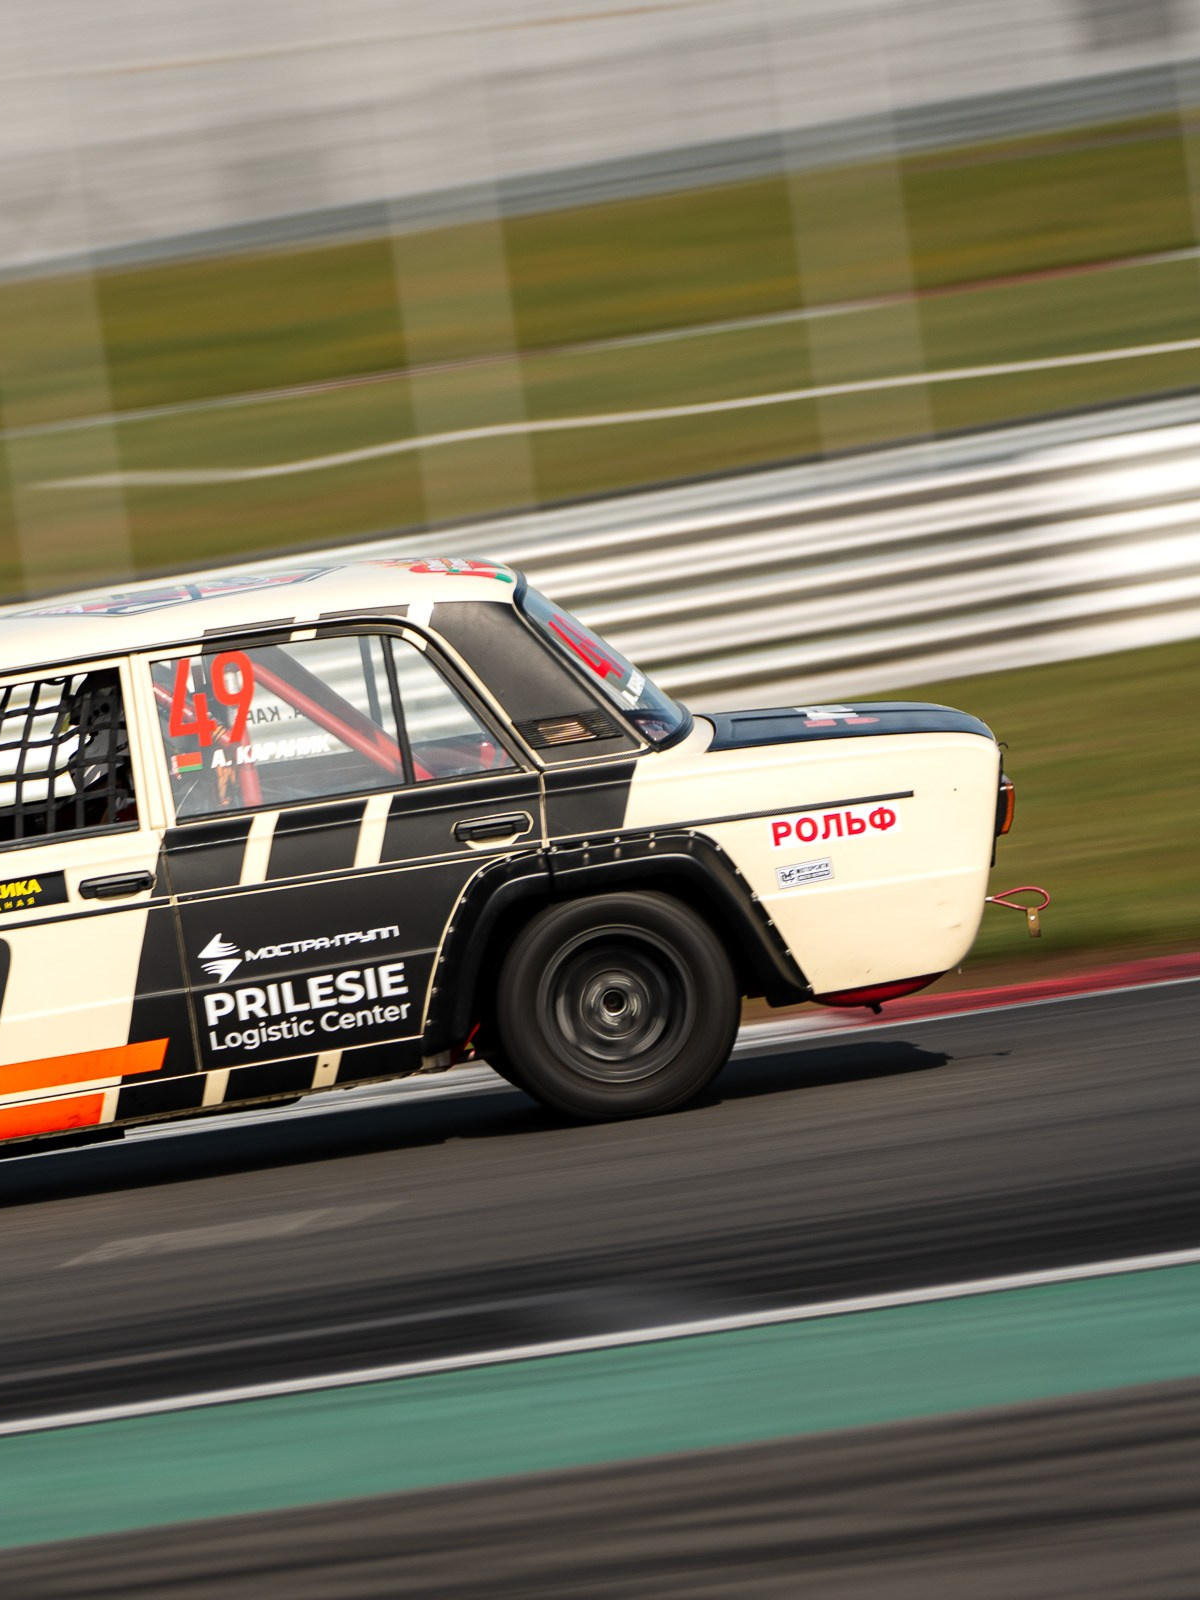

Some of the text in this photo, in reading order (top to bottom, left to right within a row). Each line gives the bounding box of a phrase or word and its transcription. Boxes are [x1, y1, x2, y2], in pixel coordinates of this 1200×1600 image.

[168, 651, 255, 747] 49
[771, 806, 897, 847] РОЛЬФ
[203, 962, 409, 1027] PRILESIE
[209, 1000, 412, 1051] Logistic Center
